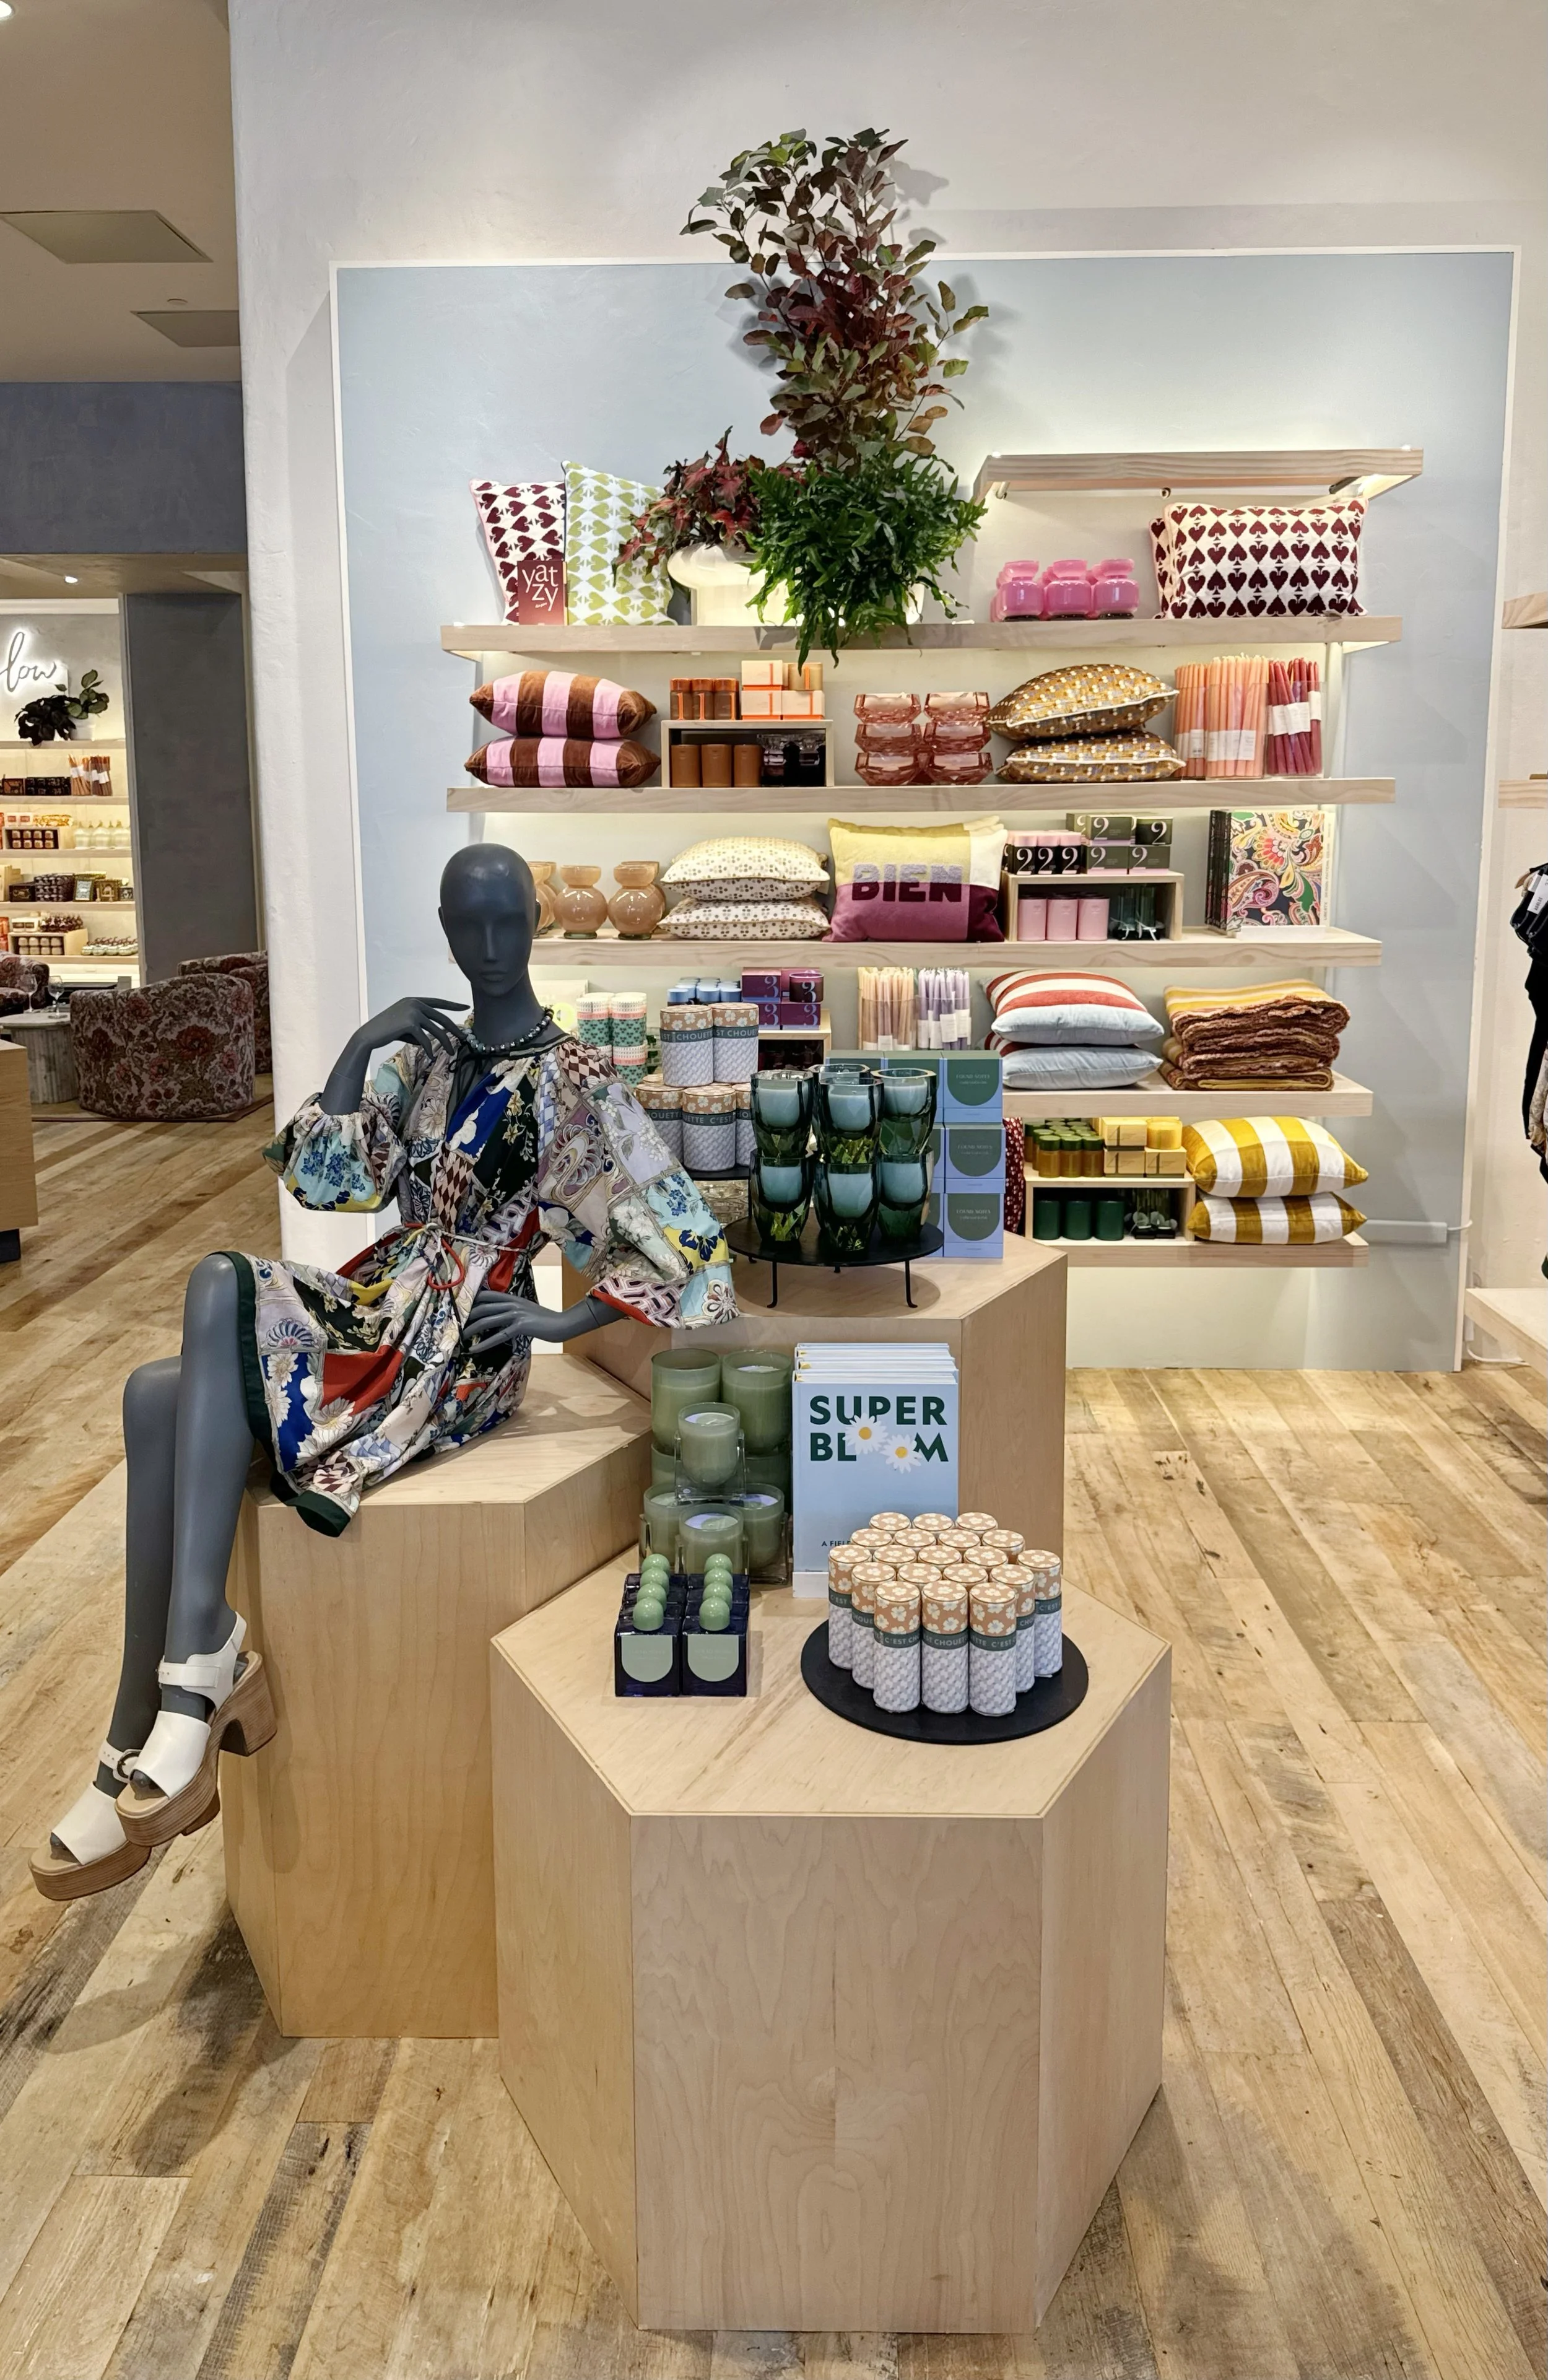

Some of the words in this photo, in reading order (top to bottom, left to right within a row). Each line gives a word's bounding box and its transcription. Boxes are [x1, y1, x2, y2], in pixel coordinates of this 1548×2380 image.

[1093, 817, 1109, 840] 2
[1150, 821, 1167, 845] 2
[1016, 848, 1032, 875] 2
[1038, 847, 1053, 874] 2
[1061, 847, 1078, 874] 2
[1090, 847, 1107, 870] 2
[1131, 847, 1147, 870] 2
[851, 863, 962, 902] BIEN
[764, 975, 779, 998] 3
[801, 980, 817, 1003] 3
[764, 1004, 779, 1026] 3
[803, 1004, 818, 1026] 3
[710, 1115, 732, 1124] C'EST
[809, 1395, 948, 1426] SUPER
[830, 1593, 848, 1605] C'EST
[884, 1636, 907, 1645] C'EST
[991, 1638, 1014, 1647] C'EST
